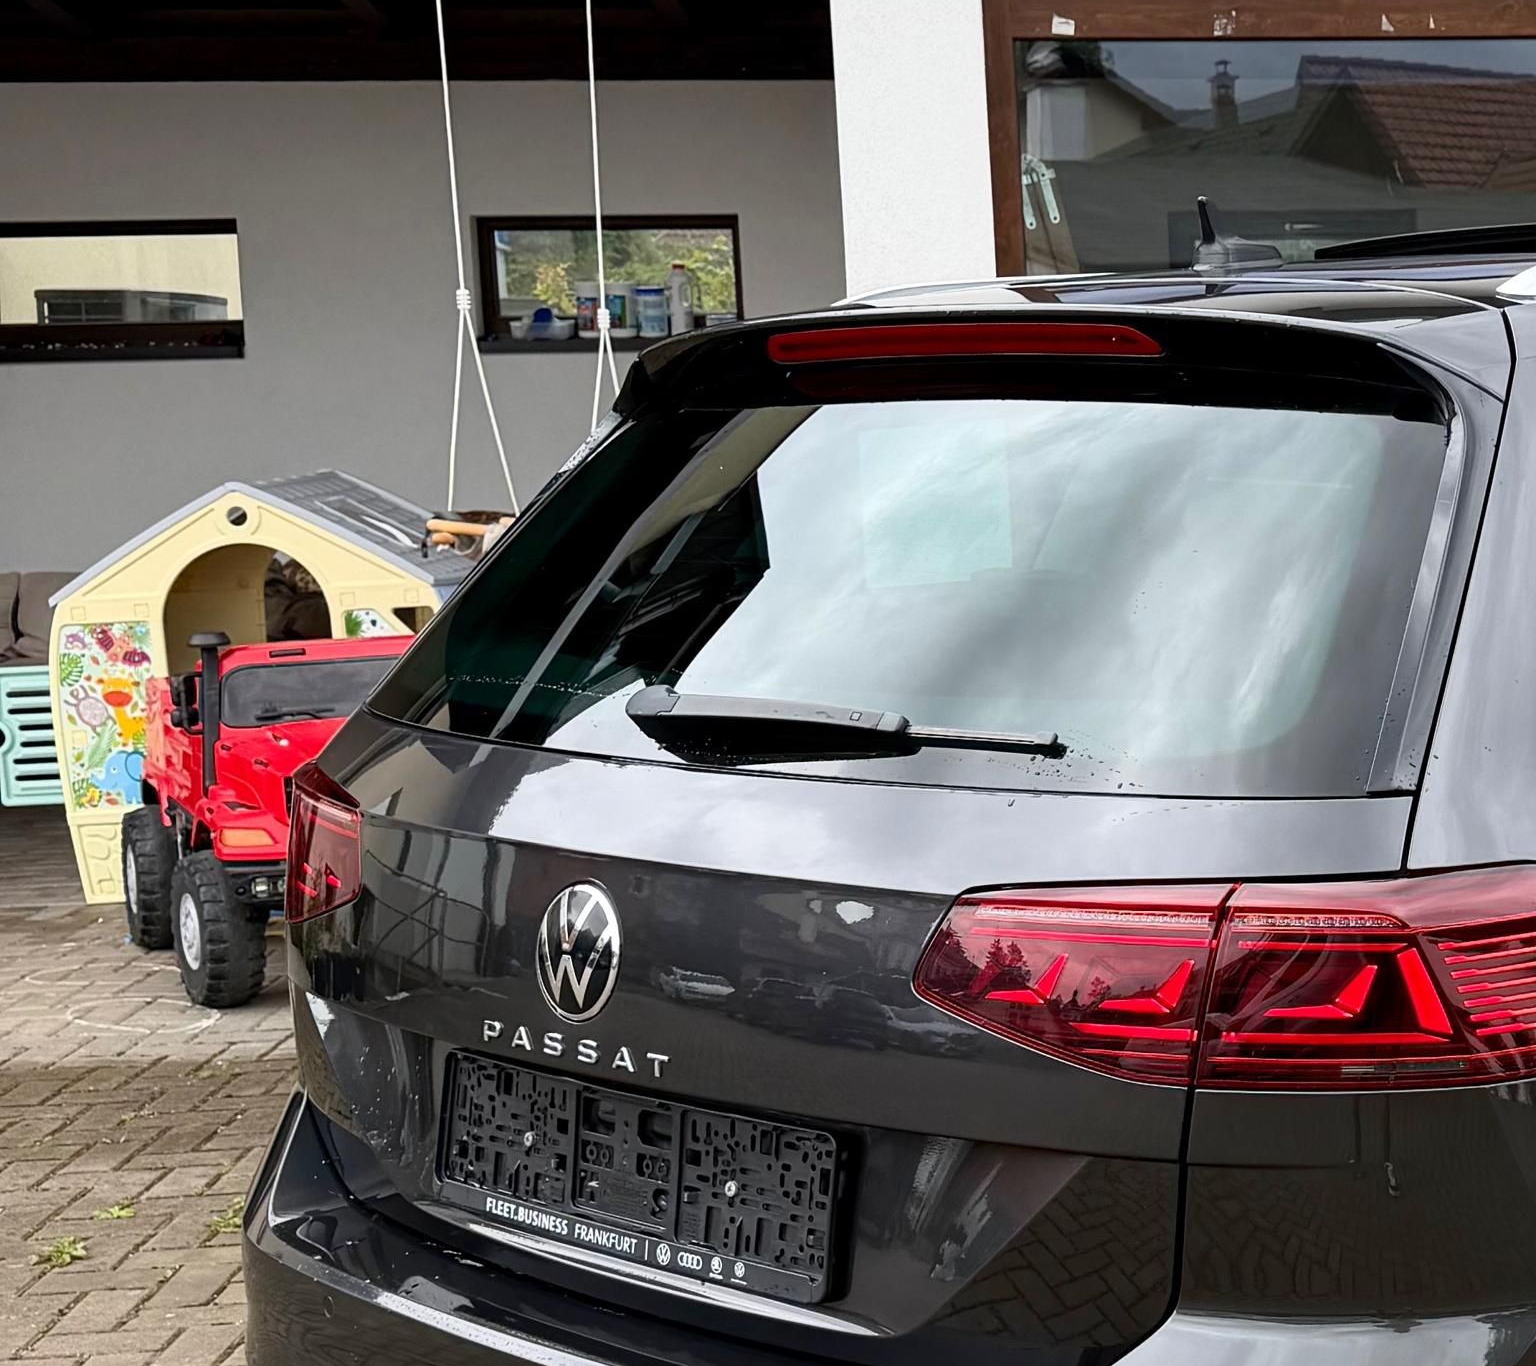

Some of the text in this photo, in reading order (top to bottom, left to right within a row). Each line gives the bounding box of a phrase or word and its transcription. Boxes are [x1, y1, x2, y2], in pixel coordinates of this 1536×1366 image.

[482, 1019, 672, 1078] PASSAT
[485, 1196, 569, 1235] FLEET.BUSINESS
[573, 1223, 638, 1255] FRANKFURT
